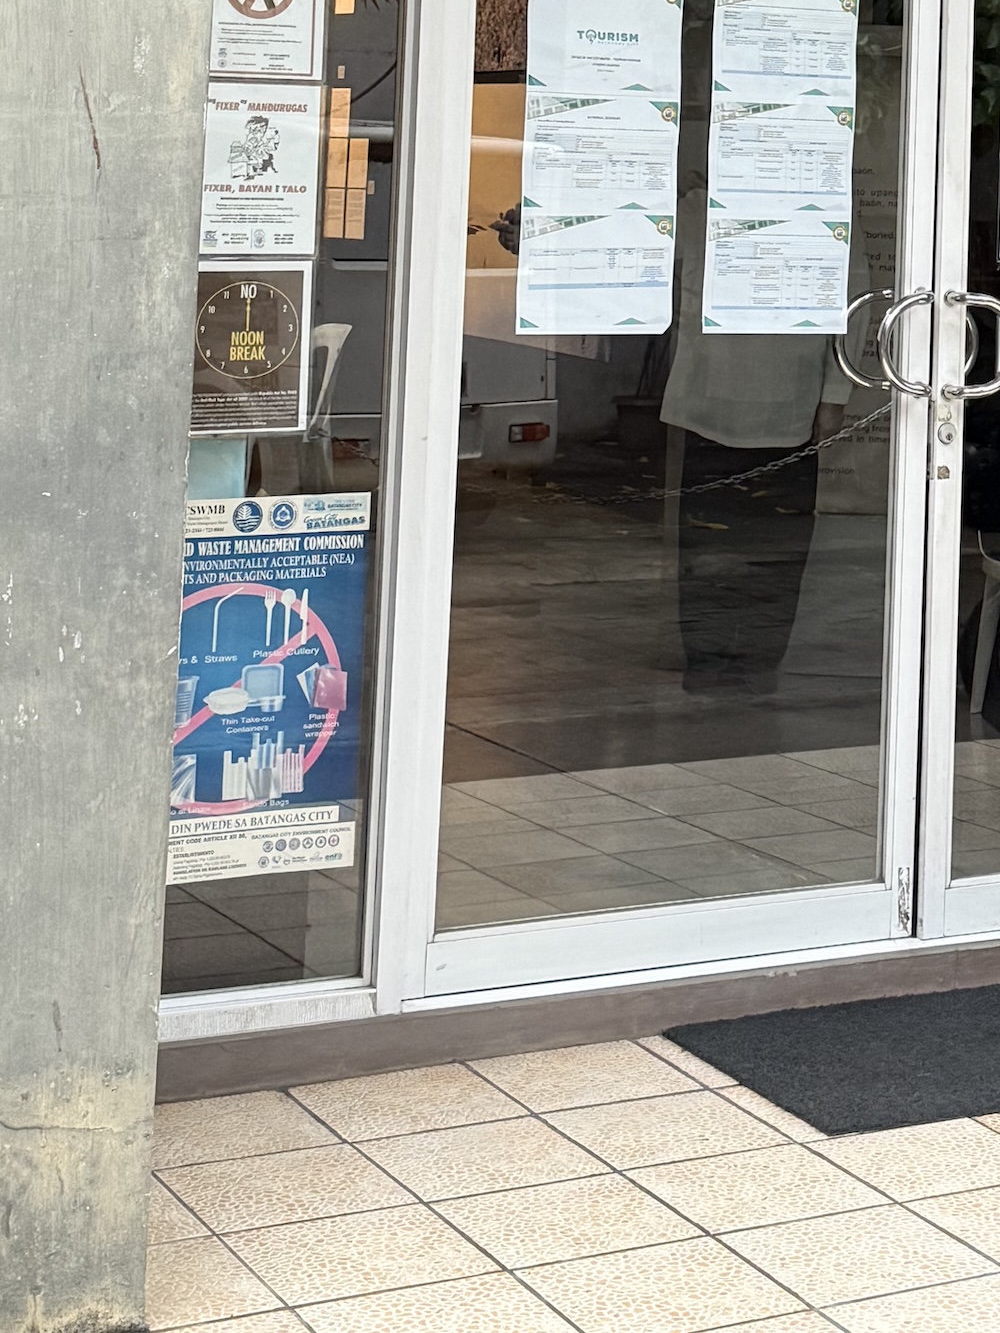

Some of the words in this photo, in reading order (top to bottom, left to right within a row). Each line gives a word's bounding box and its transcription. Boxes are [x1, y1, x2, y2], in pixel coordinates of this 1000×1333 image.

[577, 29, 639, 42] TOURISM
[247, 102, 308, 113] MANDURUGAS
[203, 184, 235, 193] FIXER,
[238, 185, 272, 193] BAYAN
[282, 186, 307, 194] TALO
[223, 291, 230, 299] 11
[240, 284, 257, 299] NO
[208, 305, 216, 314] 10
[283, 305, 288, 313] 2
[200, 325, 206, 334] 9
[231, 331, 265, 346] NOON
[206, 349, 211, 358] 8
[229, 346, 266, 362] BREAK
[281, 348, 286, 356] 4
[221, 361, 225, 370] 7
[243, 366, 249, 374] 6
[187, 505, 225, 514] SWMB
[306, 516, 366, 530] BATANGAS
[198, 540, 232, 556] WASTE
[234, 537, 301, 555] MANAGEMENT
[303, 534, 364, 551] COMMISSION
[270, 554, 329, 568] ACCEPTABLE
[329, 553, 355, 566] (NEA)
[195, 573, 217, 584] AND
[218, 569, 273, 582] PACKAGING
[275, 566, 327, 580] MATERIALS
[253, 649, 284, 658] Plastic
[286, 647, 320, 656] Cutlery
[204, 655, 238, 664] Straws
[226, 725, 269, 734] Containers
[270, 799, 290, 807] Bags
[171, 823, 192, 834] DIN
[194, 819, 232, 832] PWEDE
[235, 818, 247, 828] SA
[250, 812, 306, 826] BATANGAS
[308, 810, 333, 821] CITY
[292, 829, 329, 837] ENVIRONMENT
